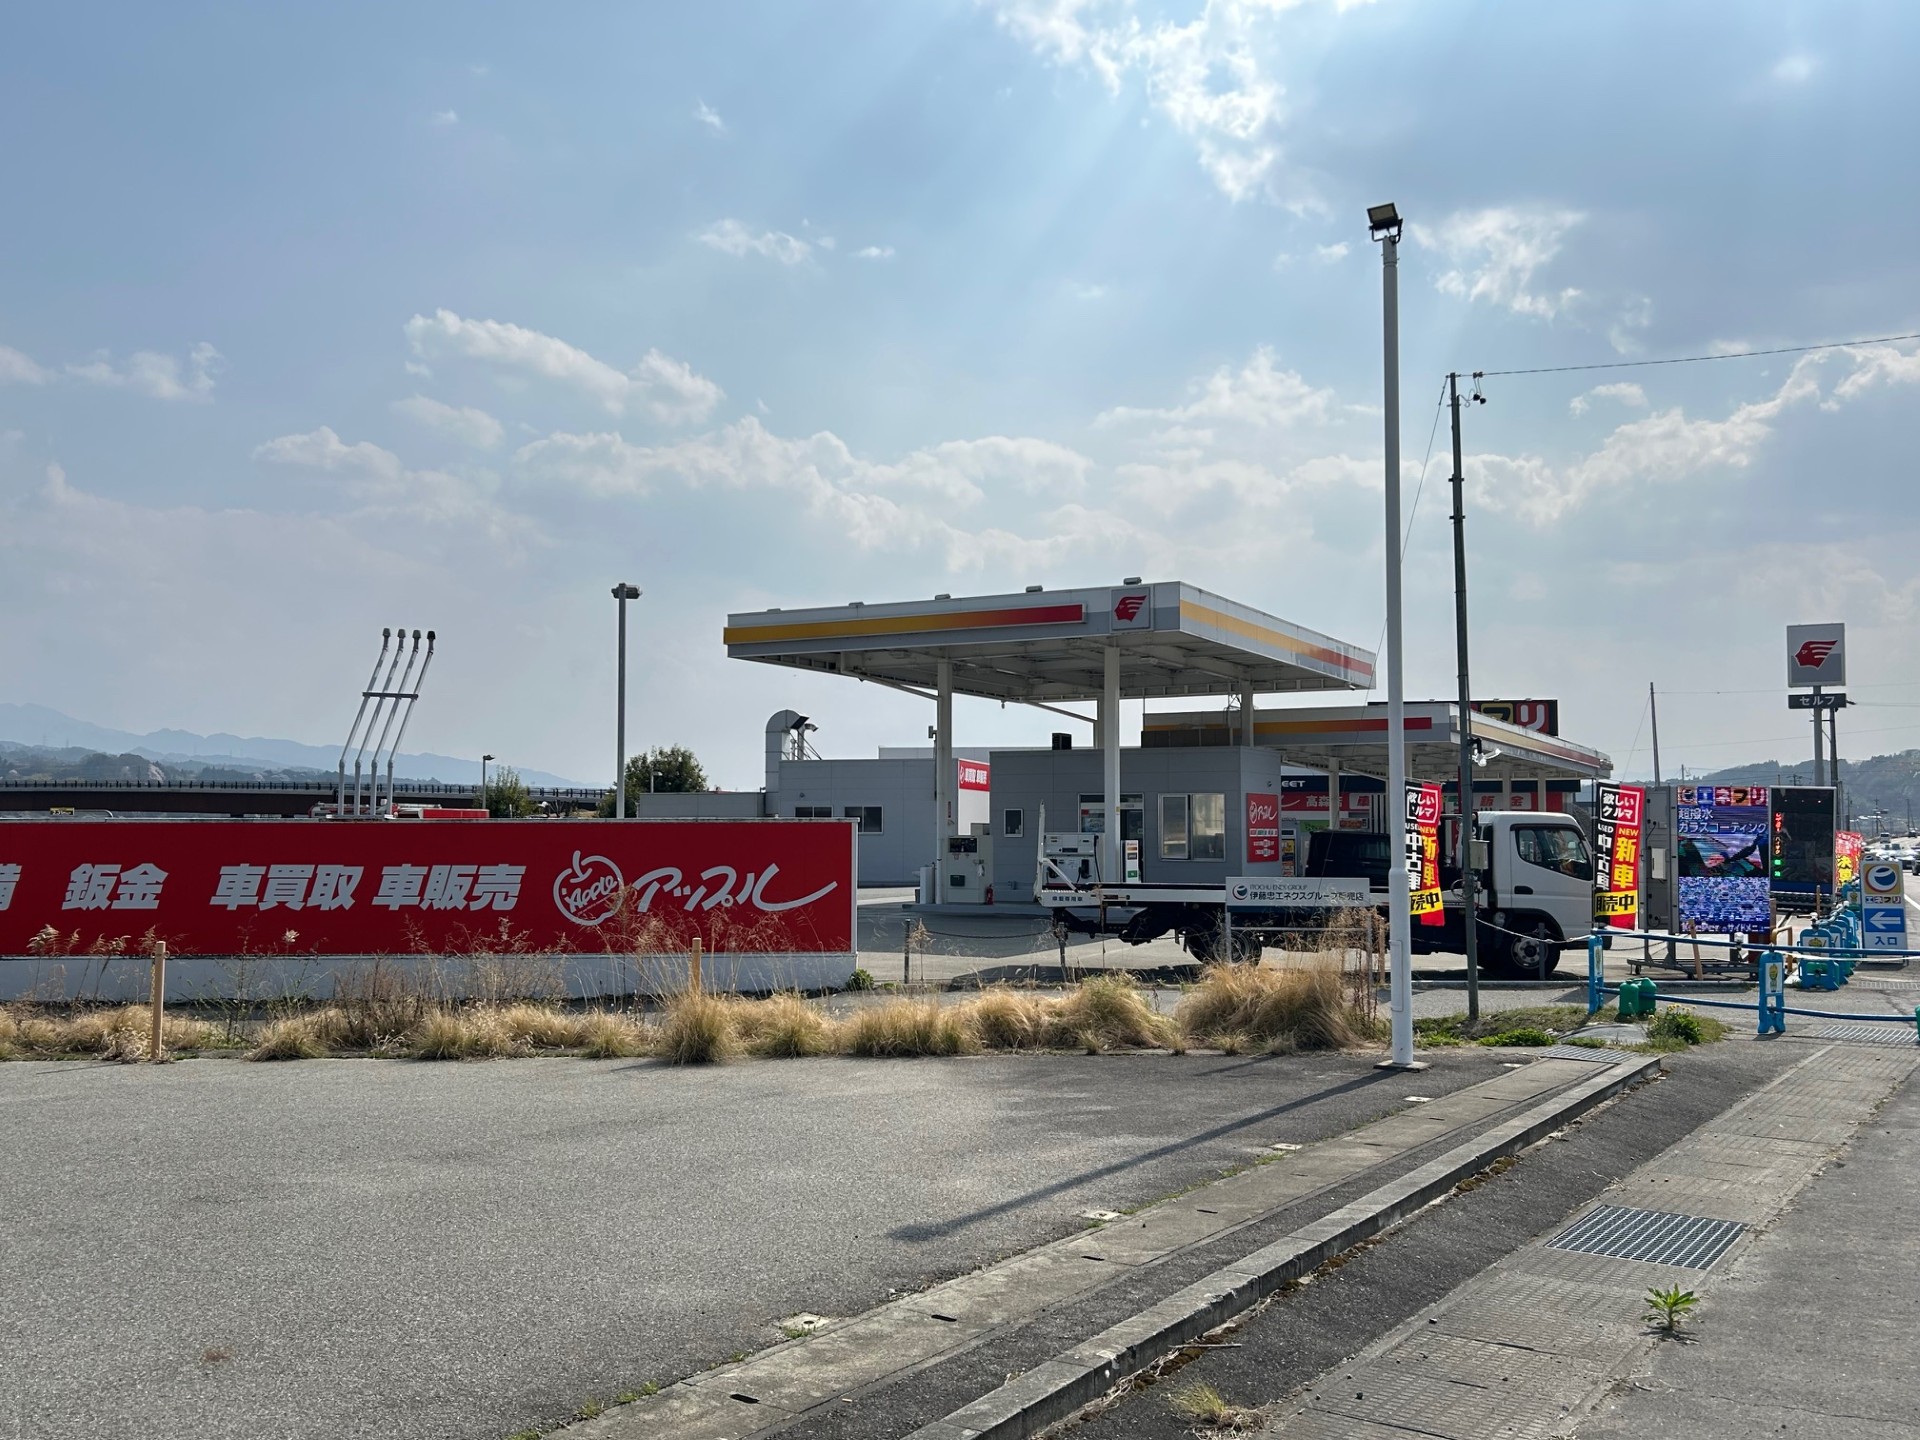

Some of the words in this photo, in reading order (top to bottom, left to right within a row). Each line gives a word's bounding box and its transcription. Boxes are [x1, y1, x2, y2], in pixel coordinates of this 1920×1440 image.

[1799, 695, 1836, 706] セルフ
[1602, 792, 1635, 807] 欲しい
[1698, 788, 1767, 805] エネフリ
[1411, 805, 1435, 818] ルマ
[1602, 805, 1634, 820] クルマ
[1419, 826, 1437, 835] NEW
[1618, 827, 1639, 837] NEW
[1596, 833, 1613, 891] 中古車
[1613, 836, 1638, 889] 新車
[61, 863, 169, 911] 鈑金
[209, 863, 365, 912] 車買取
[371, 863, 527, 912] 車販売
[631, 862, 838, 913] アップル
[1874, 936, 1898, 946] 入口
